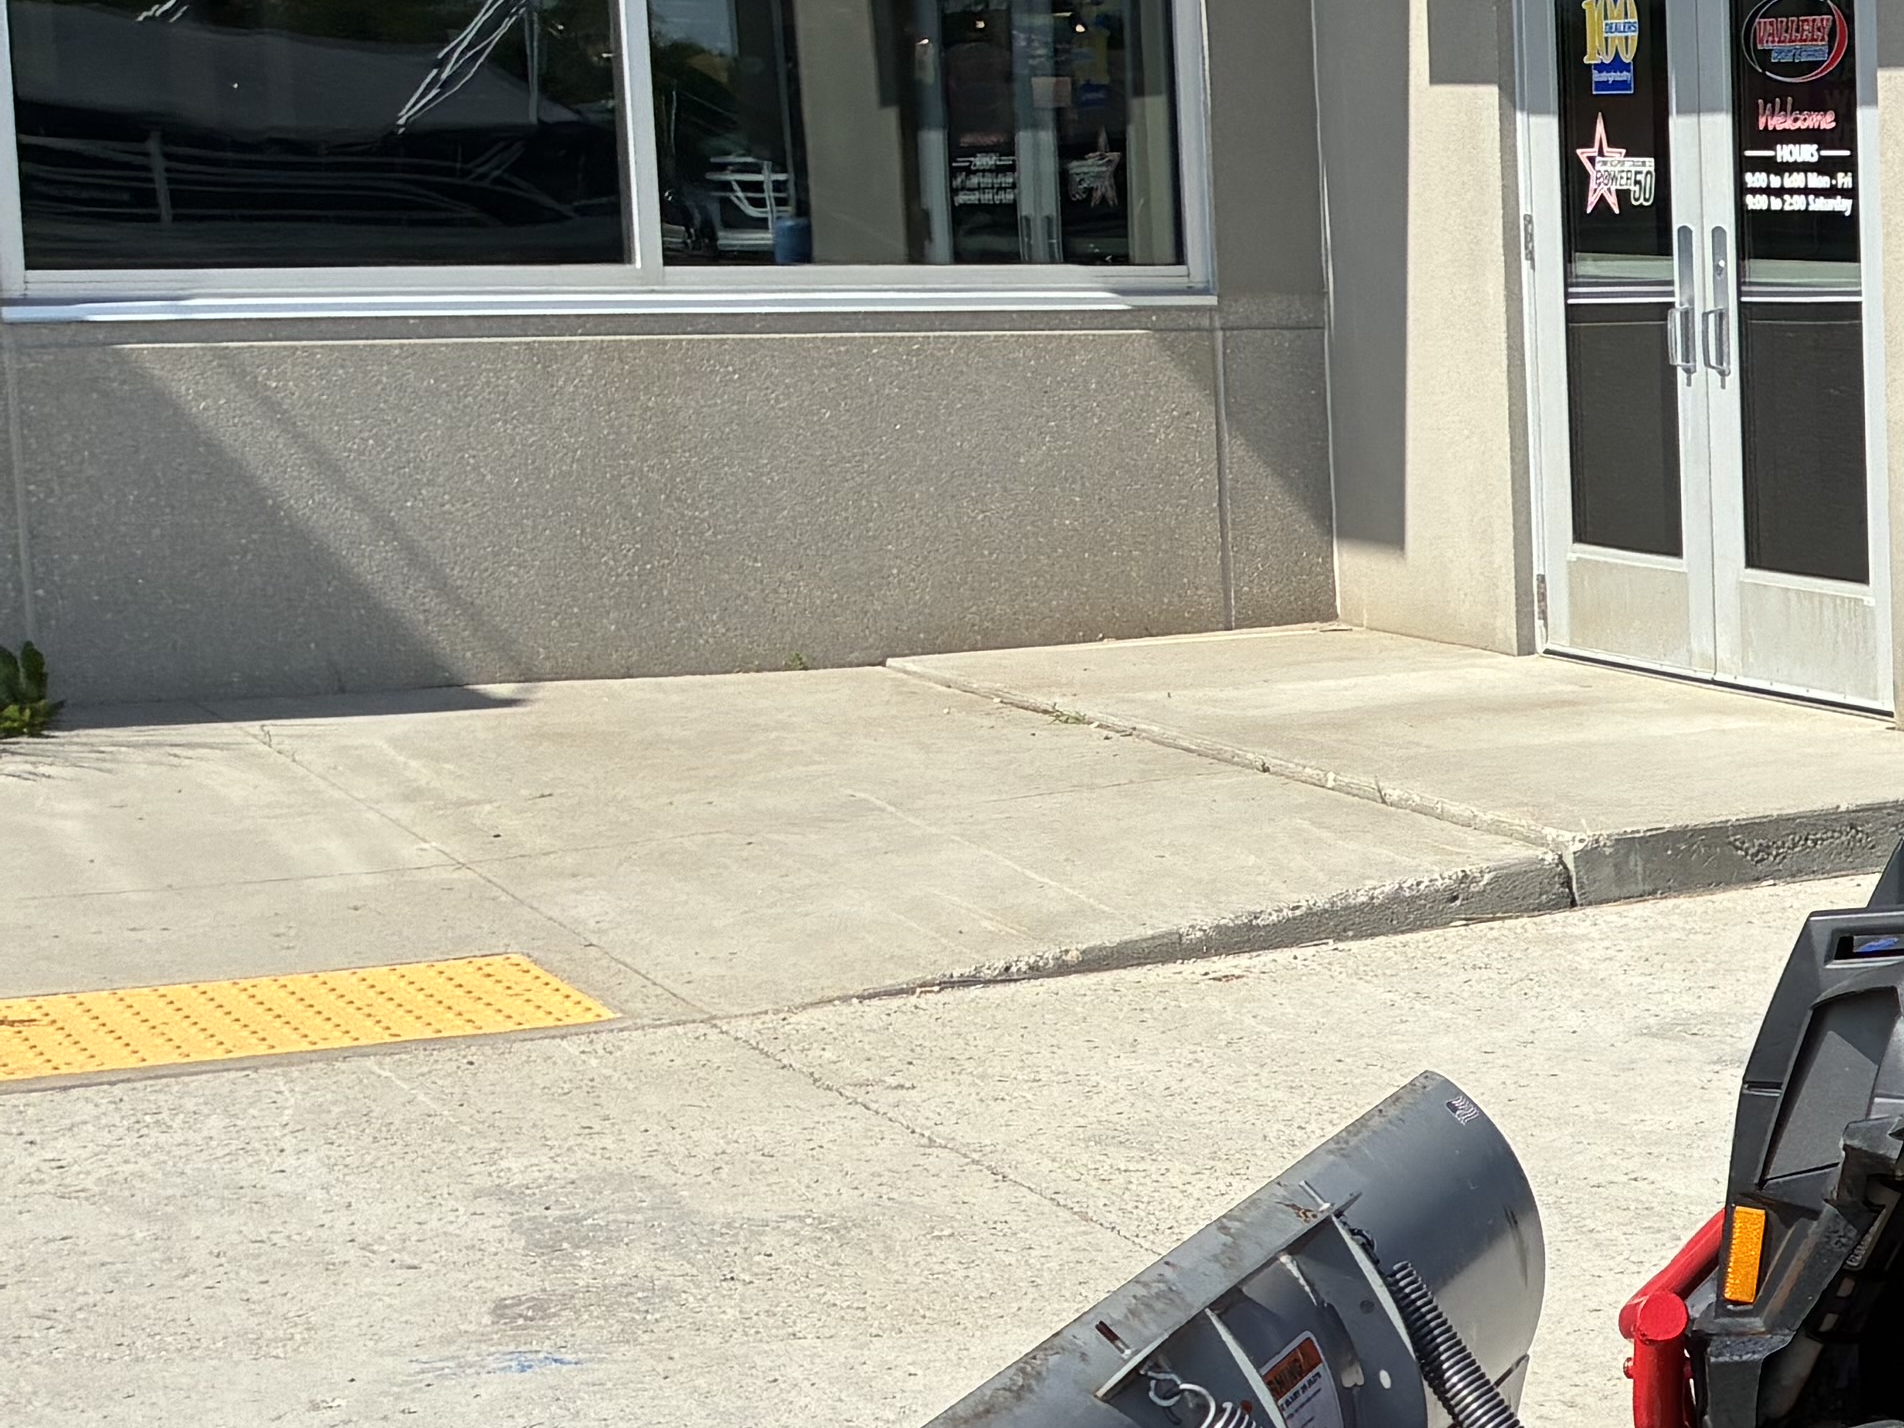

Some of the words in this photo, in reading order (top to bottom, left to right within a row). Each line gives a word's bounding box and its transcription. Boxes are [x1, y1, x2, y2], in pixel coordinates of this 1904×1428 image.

[1757, 96, 1837, 131] Welcome
[1776, 143, 1819, 163] HOURS
[1632, 169, 1654, 204] 50
